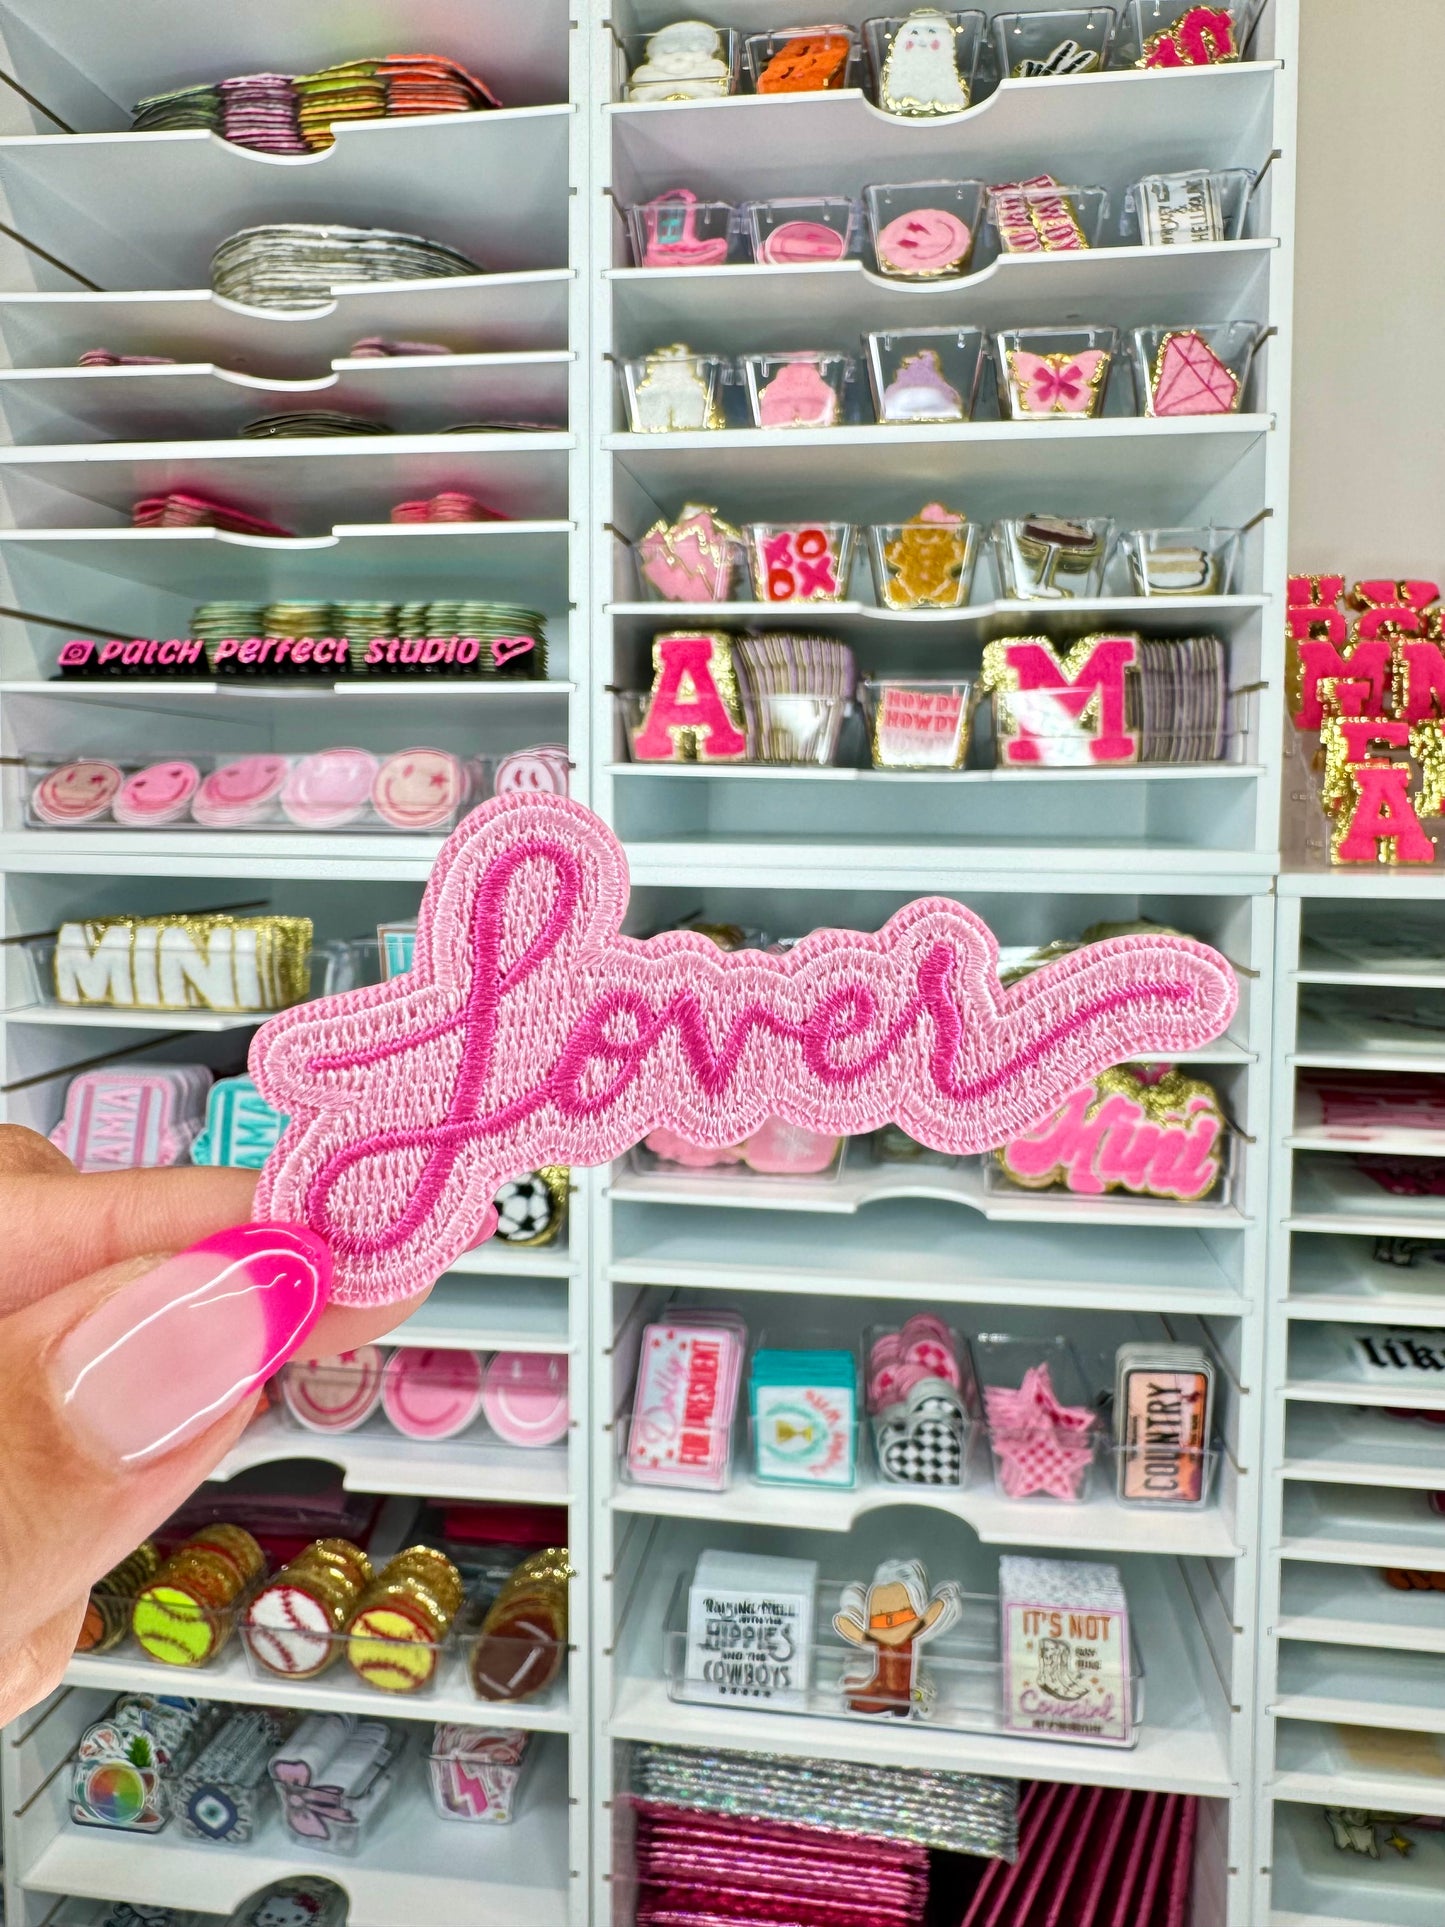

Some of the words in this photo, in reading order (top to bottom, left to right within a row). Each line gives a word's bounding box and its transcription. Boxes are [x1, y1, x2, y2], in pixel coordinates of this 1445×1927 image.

[634, 637, 746, 760] A
[886, 690, 962, 713] HOWDY
[886, 711, 960, 732] HOWDY
[1004, 639, 1137, 764] M
[1336, 767, 1437, 861] A
[57, 923, 262, 1008] MINI
[1007, 1085, 1219, 1196] Mini
[1356, 1337, 1445, 1372] lik
[1144, 1382, 1182, 1491] COUNTRY
[1022, 1610, 1063, 1638] IT'S
[1068, 1614, 1111, 1642] NOT
[703, 1660, 792, 1688] COWBOYS
